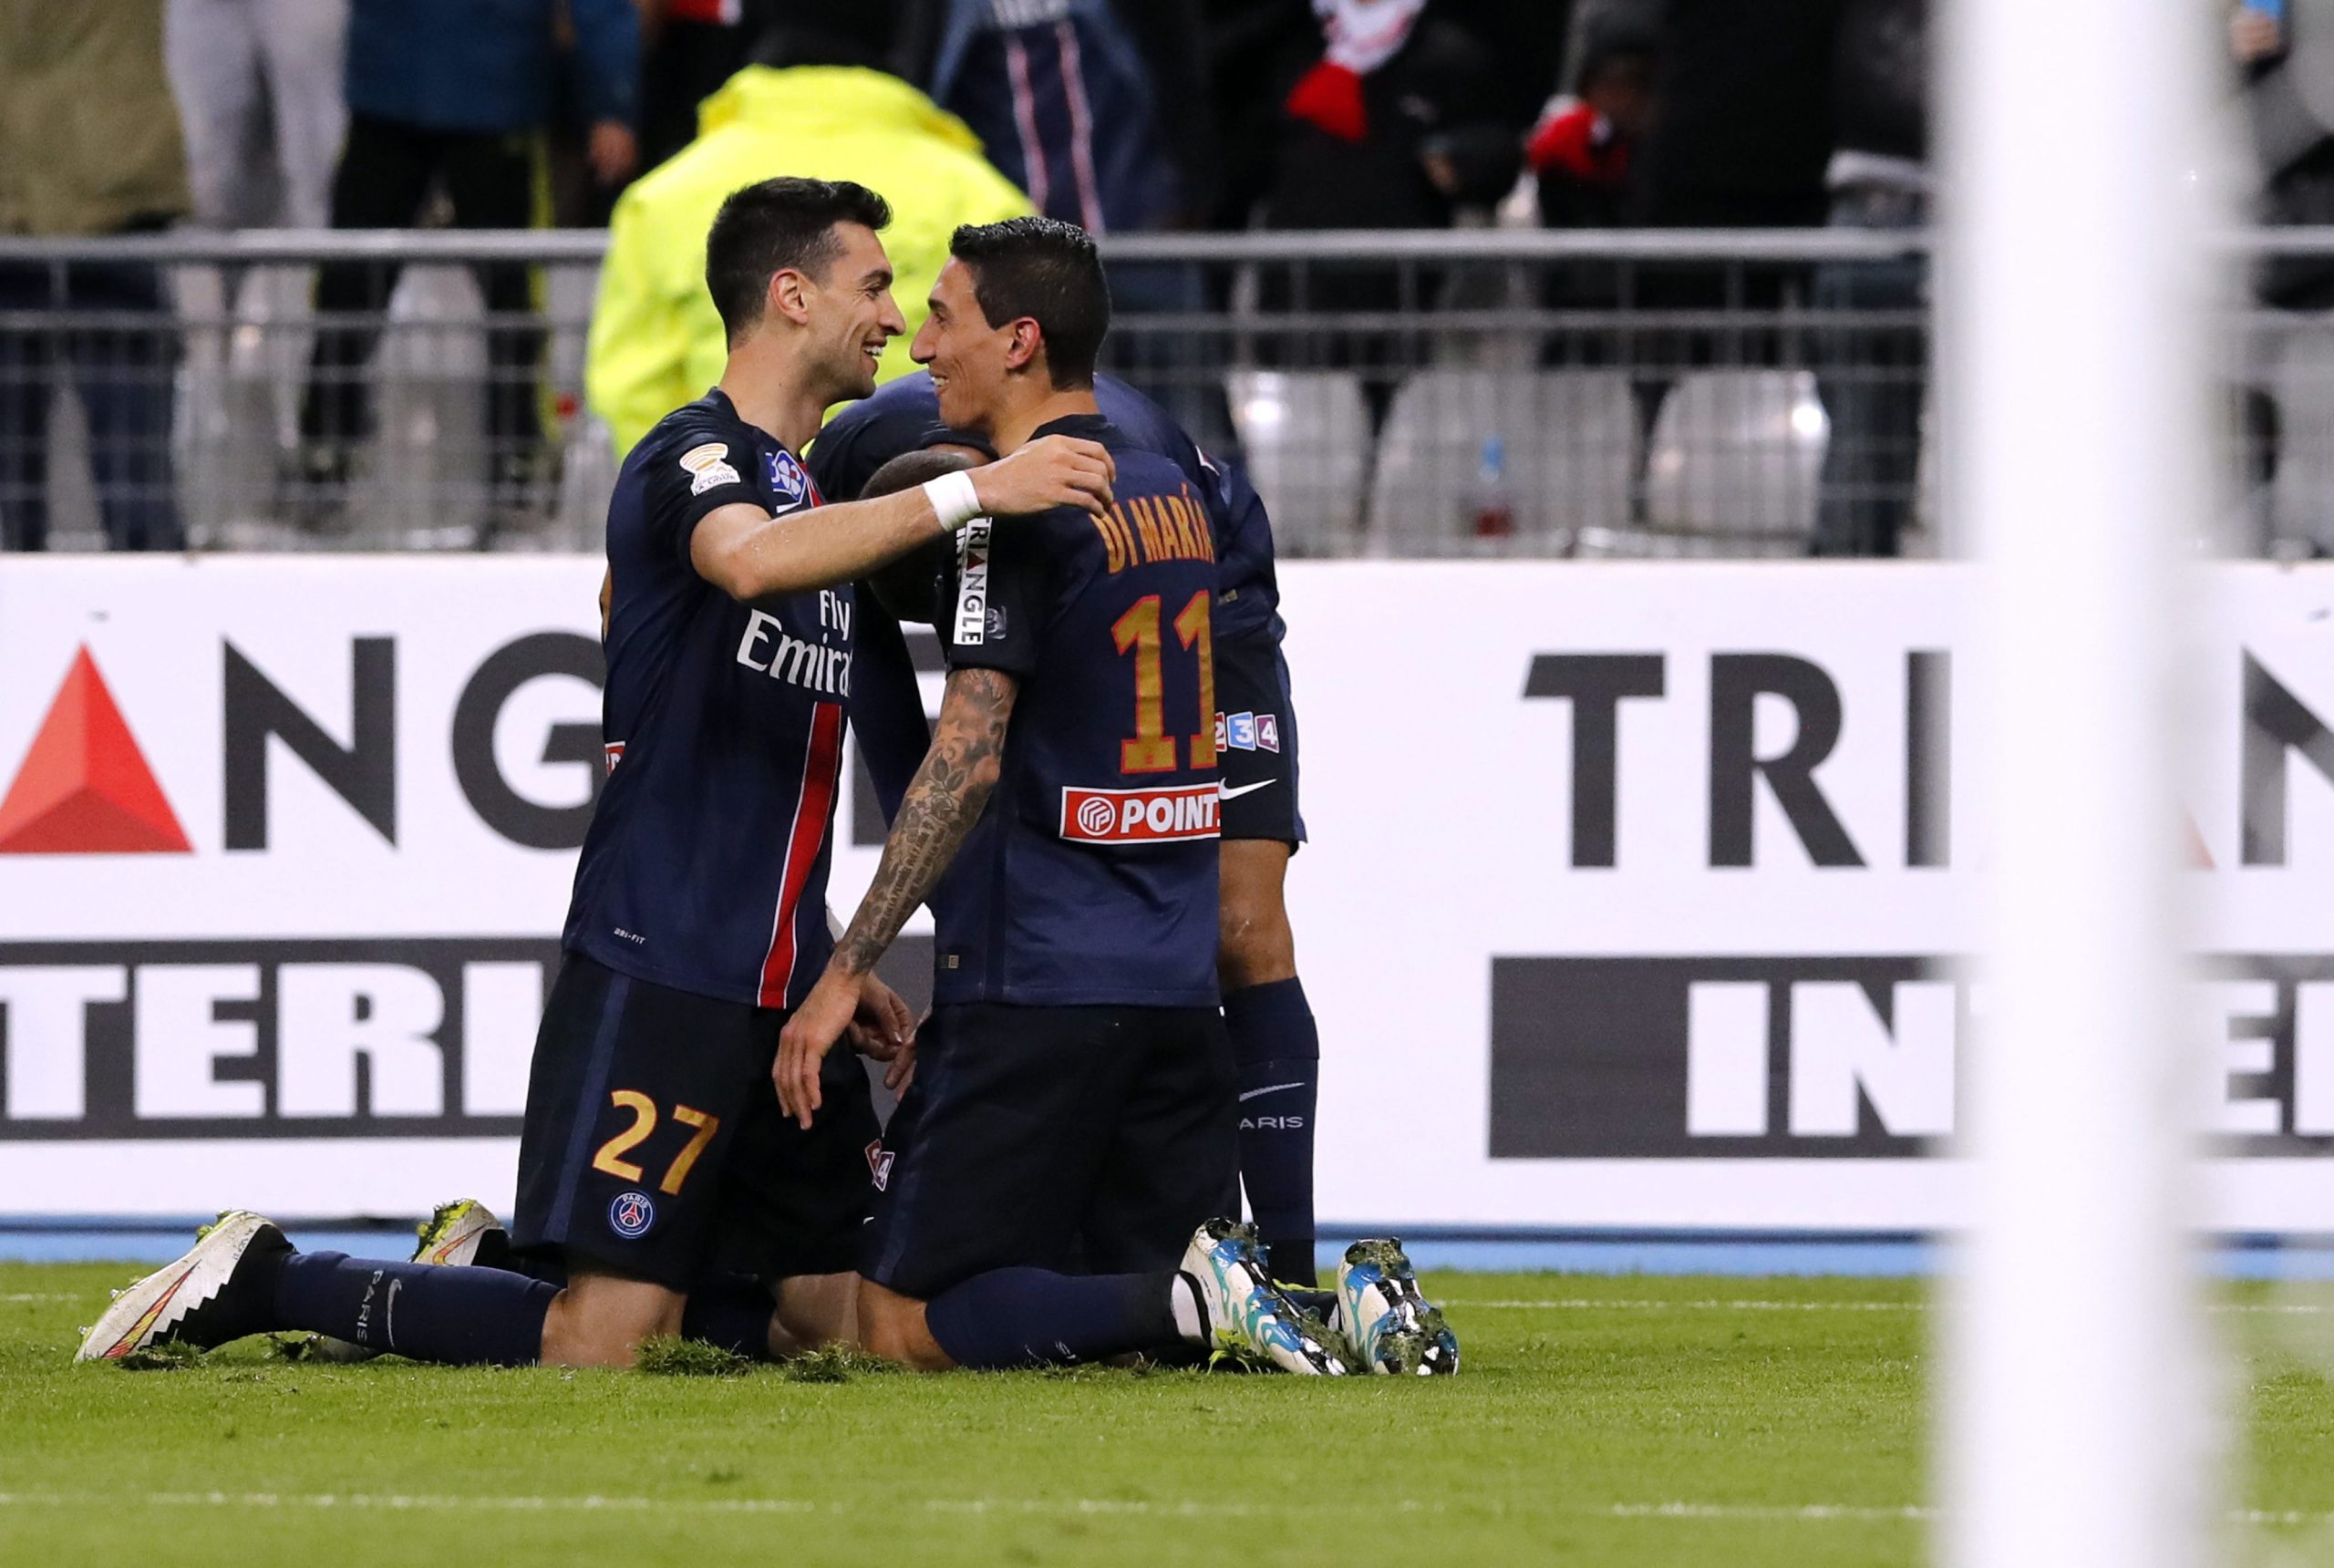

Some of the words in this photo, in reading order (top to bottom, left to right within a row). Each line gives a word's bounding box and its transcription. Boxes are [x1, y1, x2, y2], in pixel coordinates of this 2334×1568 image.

[1089, 502, 1140, 575] DI
[820, 590, 850, 641] Fly
[961, 518, 990, 643] RIANGLE
[737, 608, 852, 698] Emira
[1111, 589, 1217, 774] 11
[593, 1089, 720, 1196] 27
[1239, 1116, 1304, 1130] ARIS
[356, 1270, 383, 1342] PARIS
